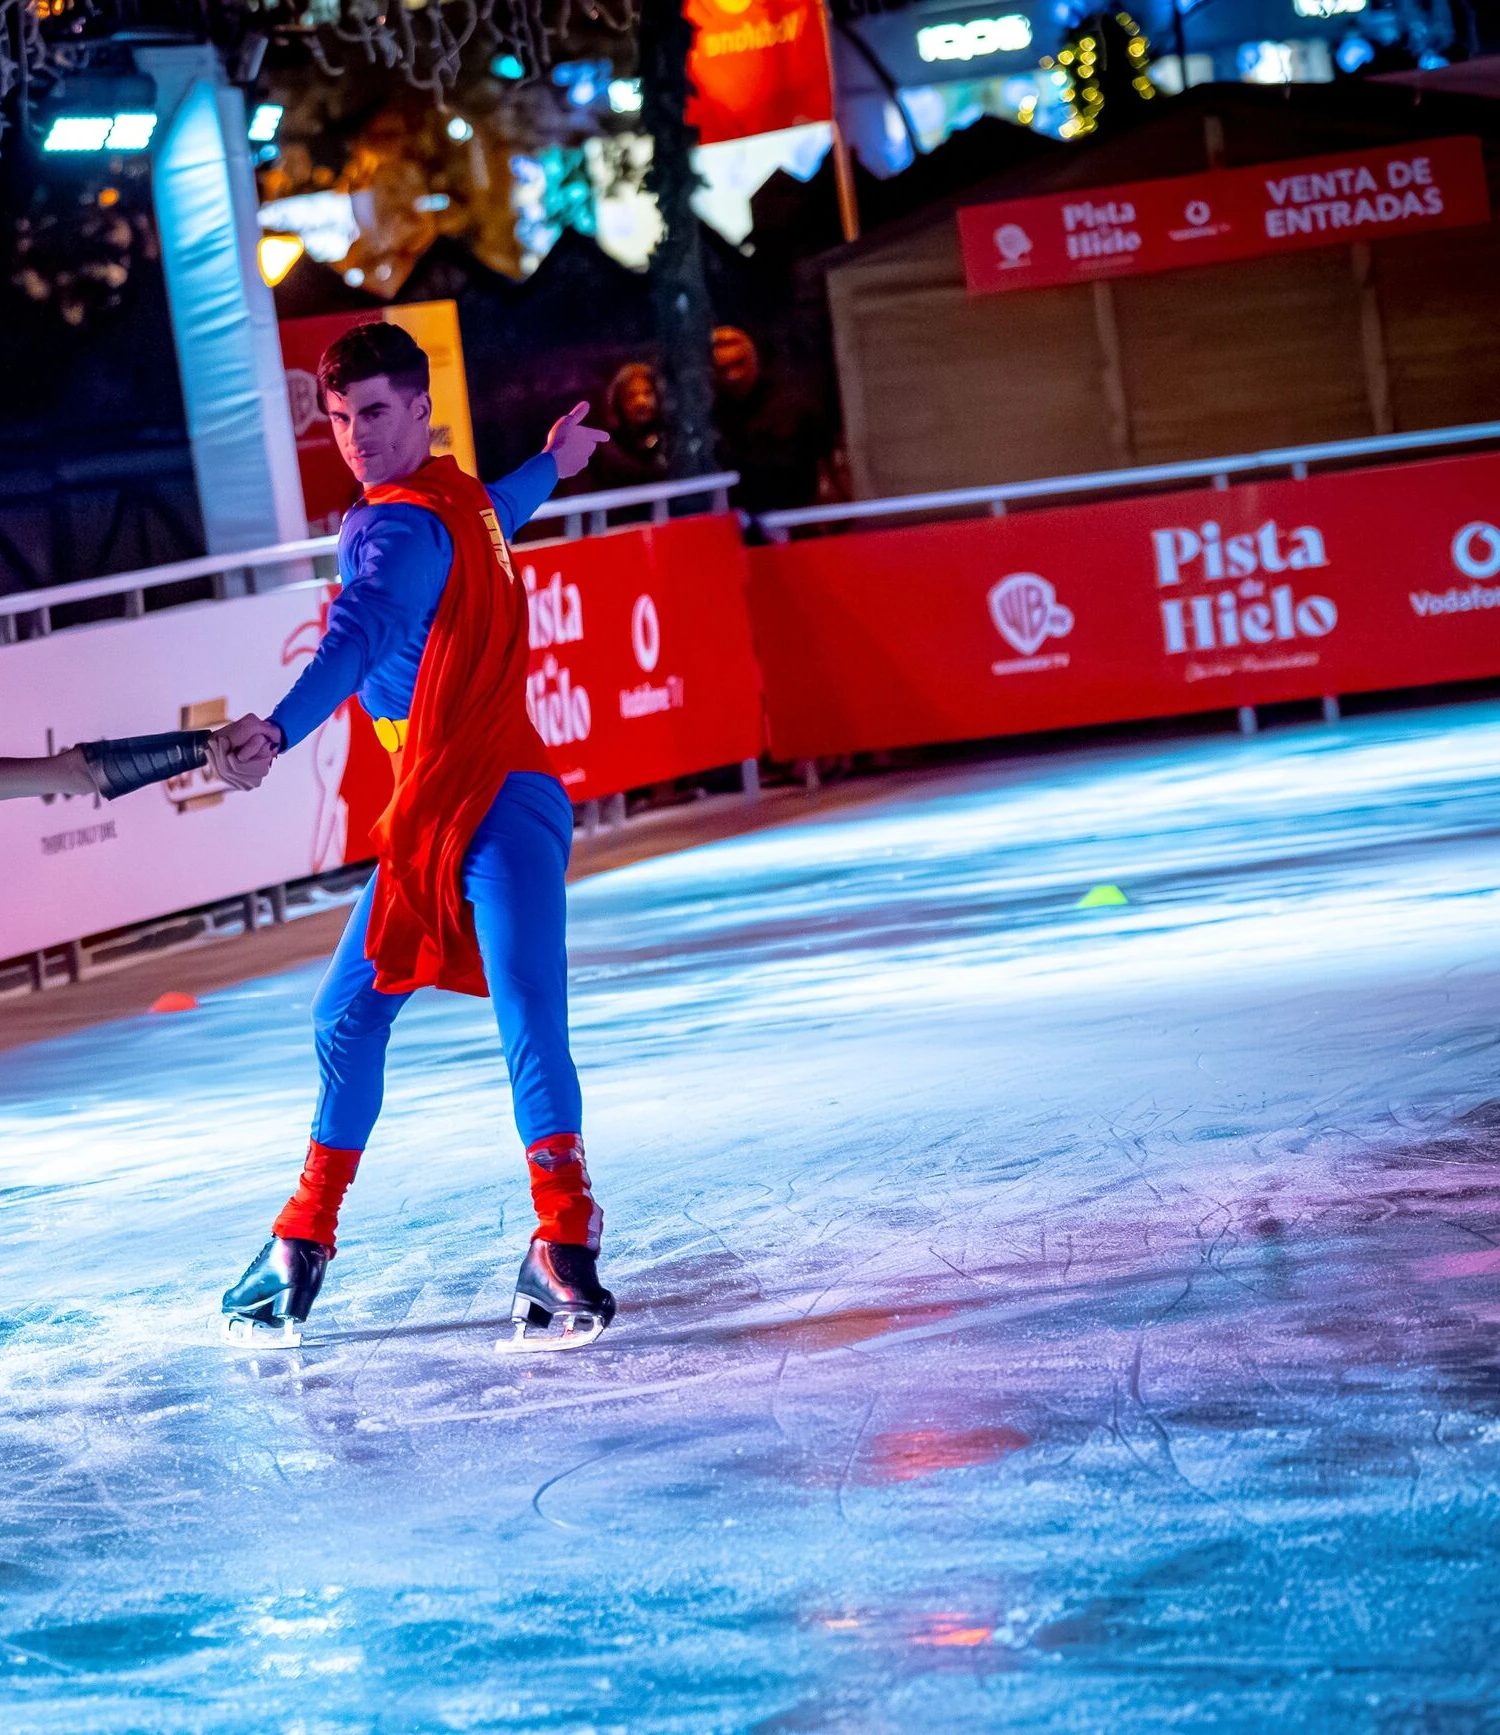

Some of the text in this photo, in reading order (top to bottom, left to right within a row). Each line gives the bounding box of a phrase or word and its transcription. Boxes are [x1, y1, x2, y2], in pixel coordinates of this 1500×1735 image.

[1264, 186, 1444, 238] ENTRADAS
[1265, 157, 1433, 206] VENTA DE
[1151, 519, 1331, 588] Pista
[522, 564, 584, 651] ista
[1161, 584, 1339, 656] Hielo
